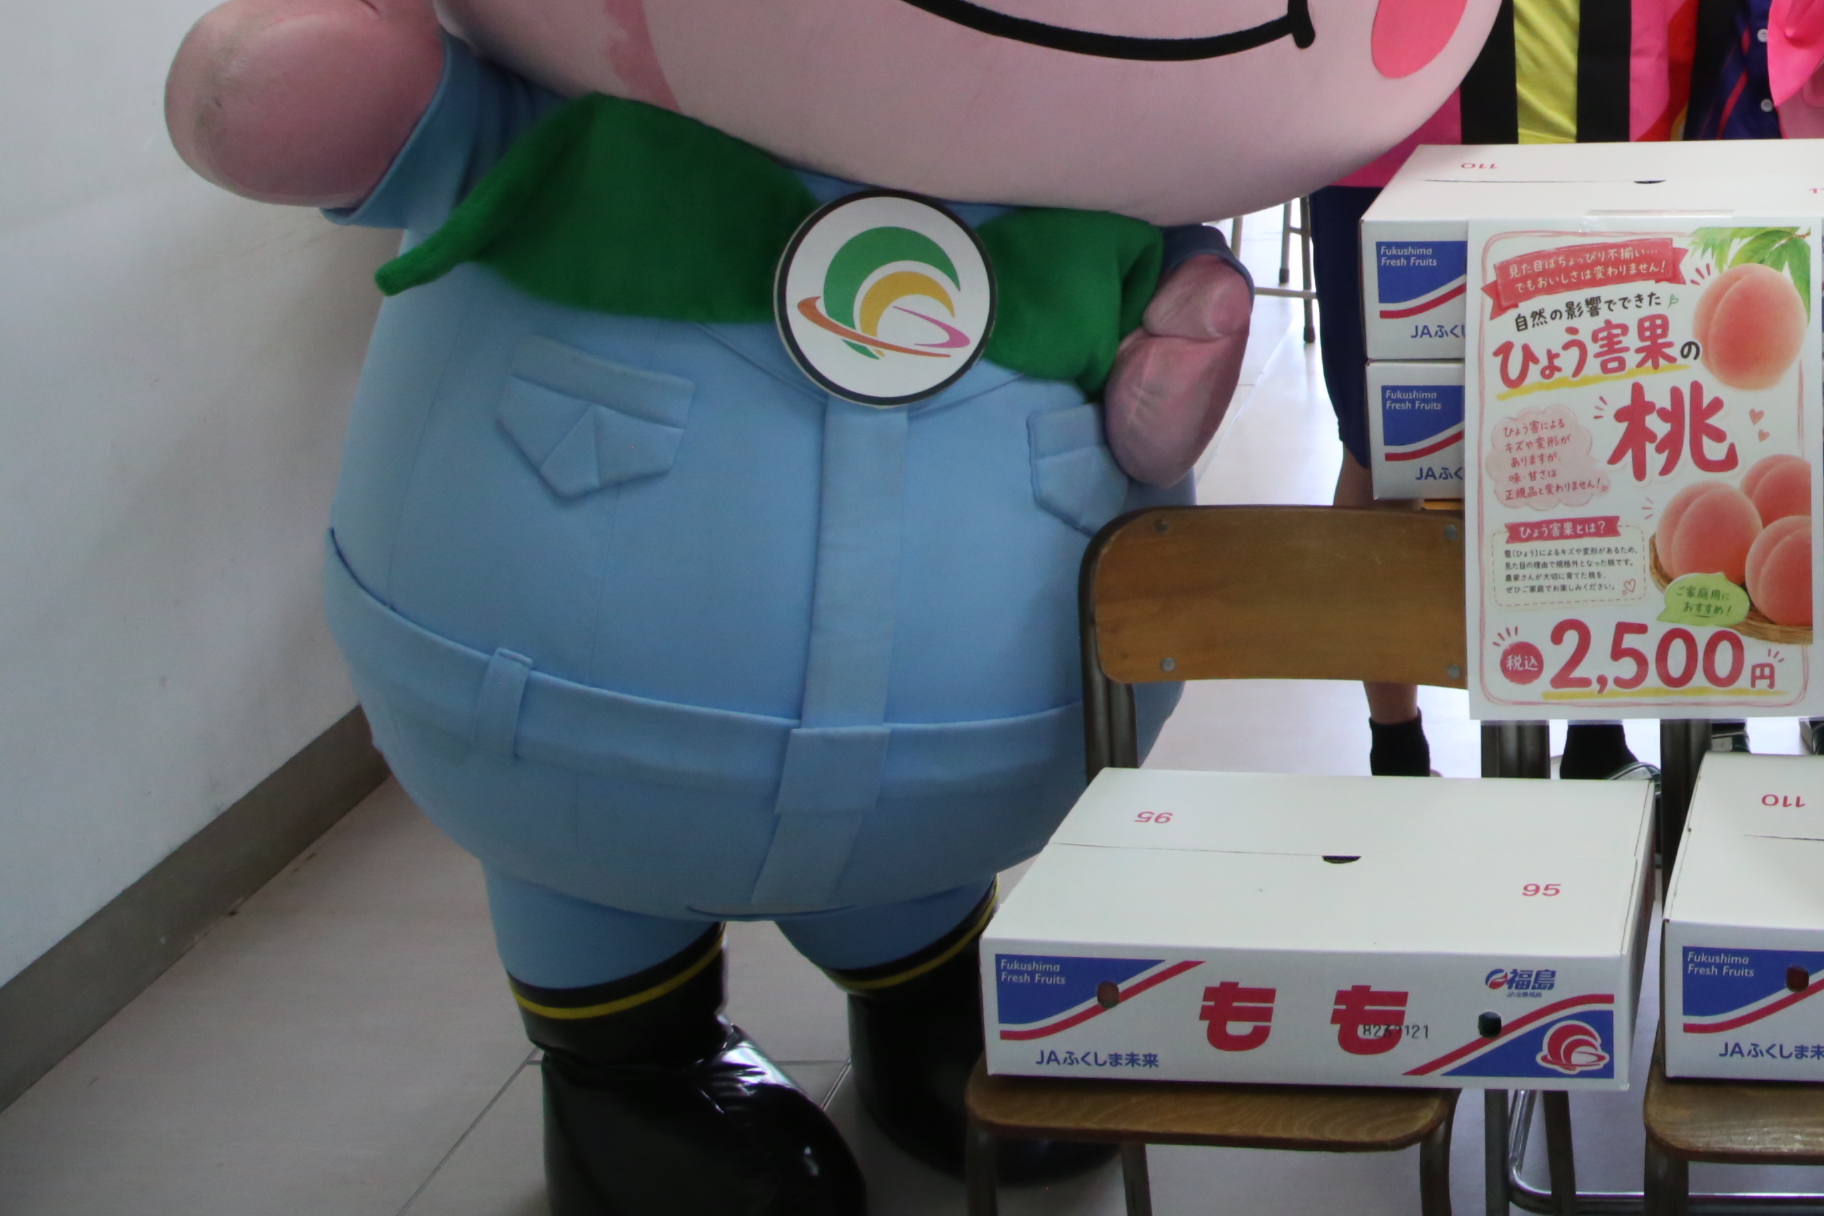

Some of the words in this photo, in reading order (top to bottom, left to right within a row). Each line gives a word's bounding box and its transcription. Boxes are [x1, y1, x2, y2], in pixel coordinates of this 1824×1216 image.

[1380, 245, 1433, 256] Fukushima
[1381, 256, 1407, 267] Fresh
[1410, 256, 1437, 267] Fruits
[1514, 291, 1662, 333] 自然の影響でできた
[1385, 389, 1438, 400] Fukushima
[1386, 400, 1412, 411] Fresh
[1415, 400, 1442, 411] Fruits
[1503, 418, 1565, 438] ひょう害による
[1607, 381, 1739, 482] 桃
[1505, 434, 1572, 453] キズや変形が
[1676, 585, 1730, 601] ご家庭用に
[1505, 654, 1539, 672] 税込
[1521, 883, 1562, 897] 95
[1687, 951, 1750, 965] Fukushima
[1000, 959, 1061, 972] Fukushima
[1687, 963, 1718, 976] Fresh
[1721, 963, 1755, 977] Fruits
[1001, 971, 1032, 983] Fresh
[1034, 972, 1066, 985] Fruits
[1507, 968, 1556, 991] 福島
[1035, 1048, 1159, 1070] JAふくしま未来
